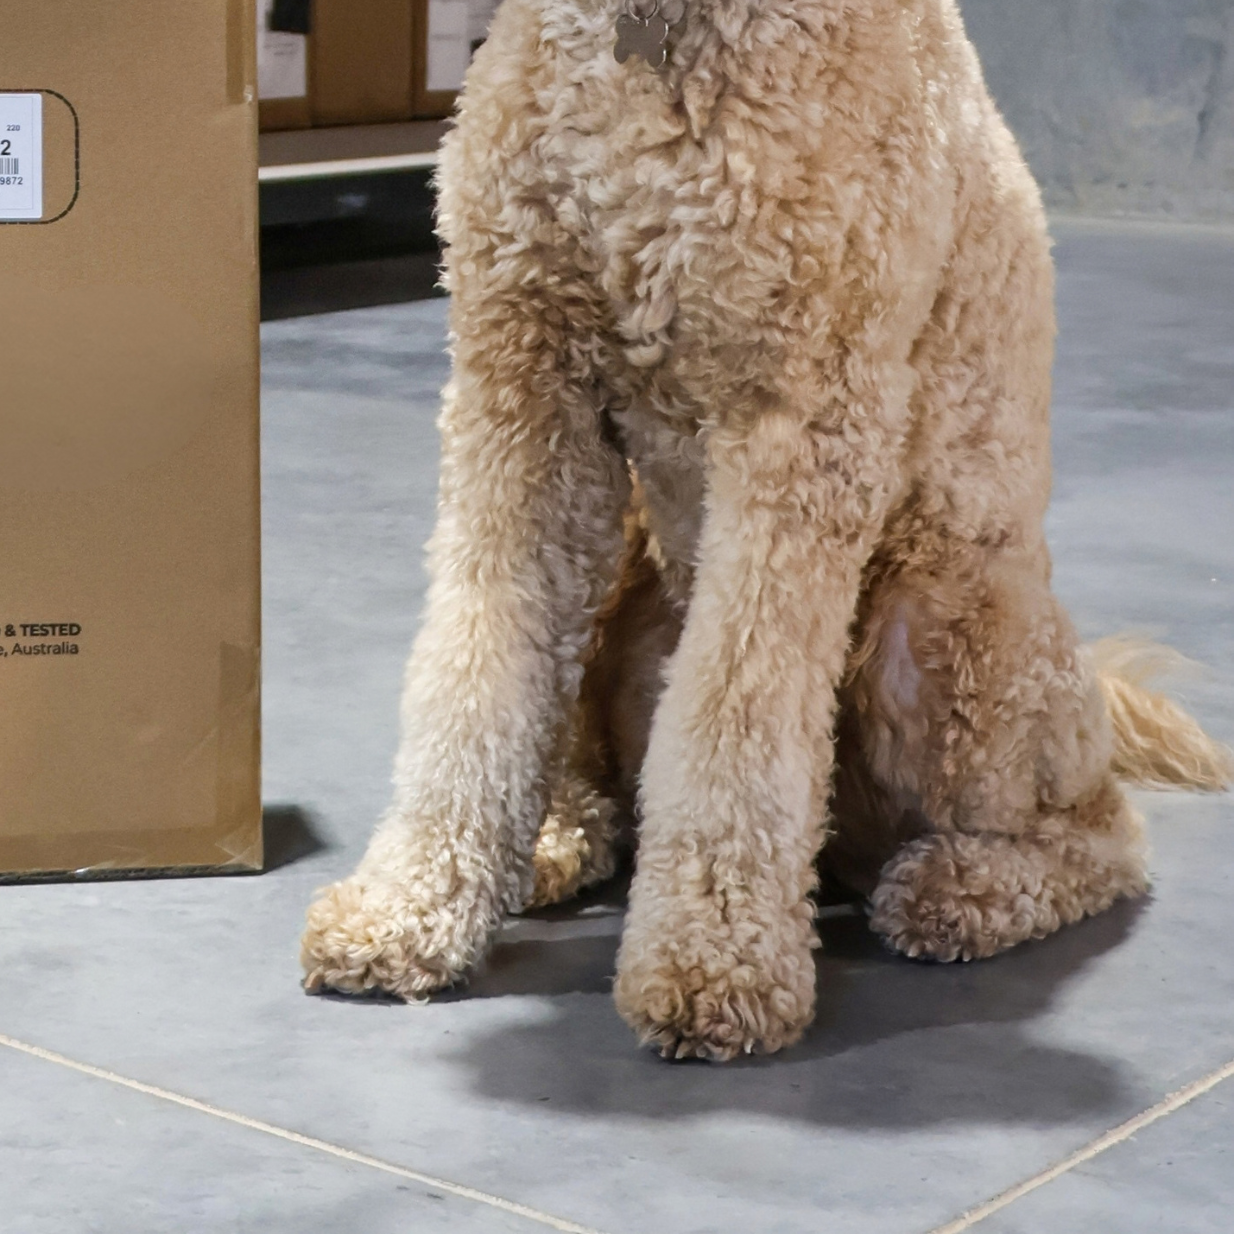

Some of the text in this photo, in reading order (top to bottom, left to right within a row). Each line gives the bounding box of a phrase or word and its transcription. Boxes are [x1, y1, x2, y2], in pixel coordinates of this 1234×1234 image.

[4, 624, 16, 637] &
[19, 623, 82, 637] TESTED
[11, 642, 80, 656] Australia
